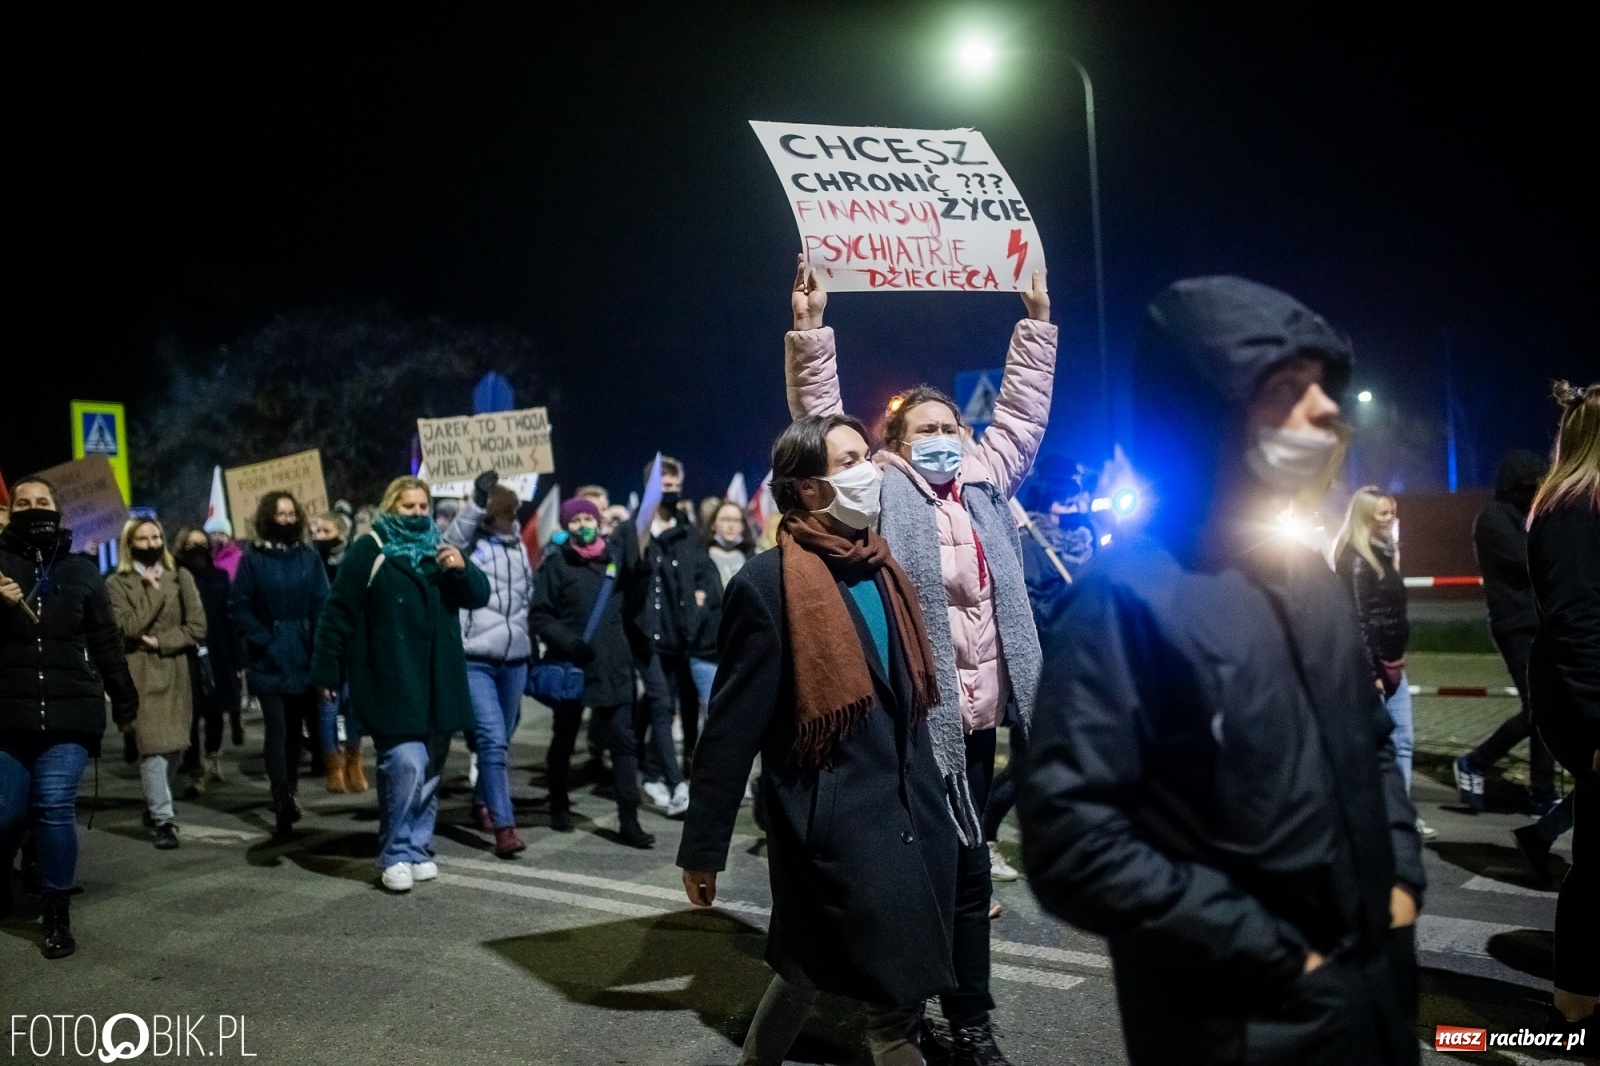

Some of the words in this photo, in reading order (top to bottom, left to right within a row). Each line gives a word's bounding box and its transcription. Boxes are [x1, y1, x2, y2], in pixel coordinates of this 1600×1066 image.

[779, 133, 989, 166] CHCESZ
[791, 164, 949, 193] CHRONIĆ
[956, 173, 1004, 194] ???
[796, 199, 942, 237] FINANSUJ
[937, 191, 1032, 222] ŻYCIE
[422, 420, 470, 441] JAREK
[475, 418, 496, 434] TO
[502, 413, 548, 432] TWOJA
[423, 440, 462, 457] WINA
[467, 436, 513, 453] TWOJA
[426, 457, 482, 478] WIELKA
[490, 453, 524, 471] WINA
